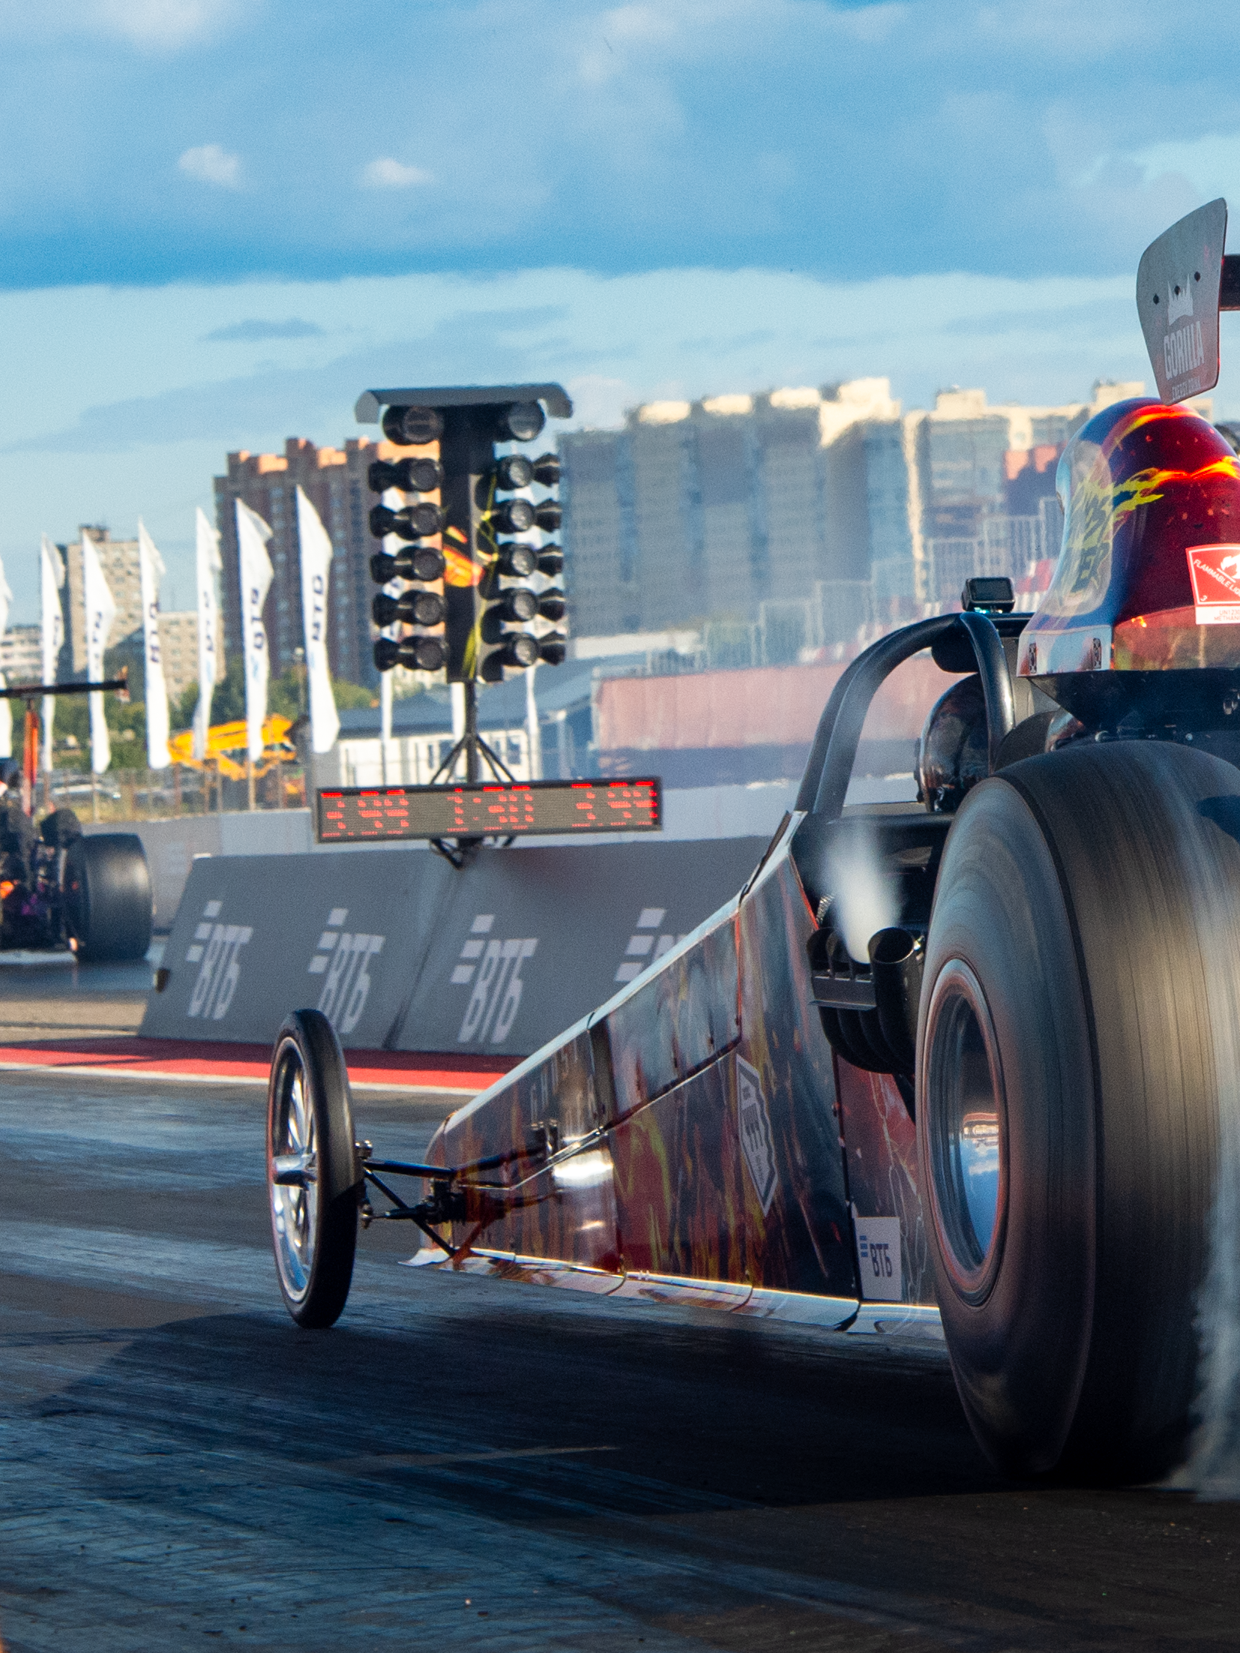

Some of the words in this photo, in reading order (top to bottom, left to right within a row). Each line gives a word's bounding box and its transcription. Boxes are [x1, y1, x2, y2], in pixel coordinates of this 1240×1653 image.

[1163, 320, 1205, 381] GORILLA
[1193, 559, 1230, 588] FLAMMABLE
[869, 1243, 893, 1278] ВТБ
